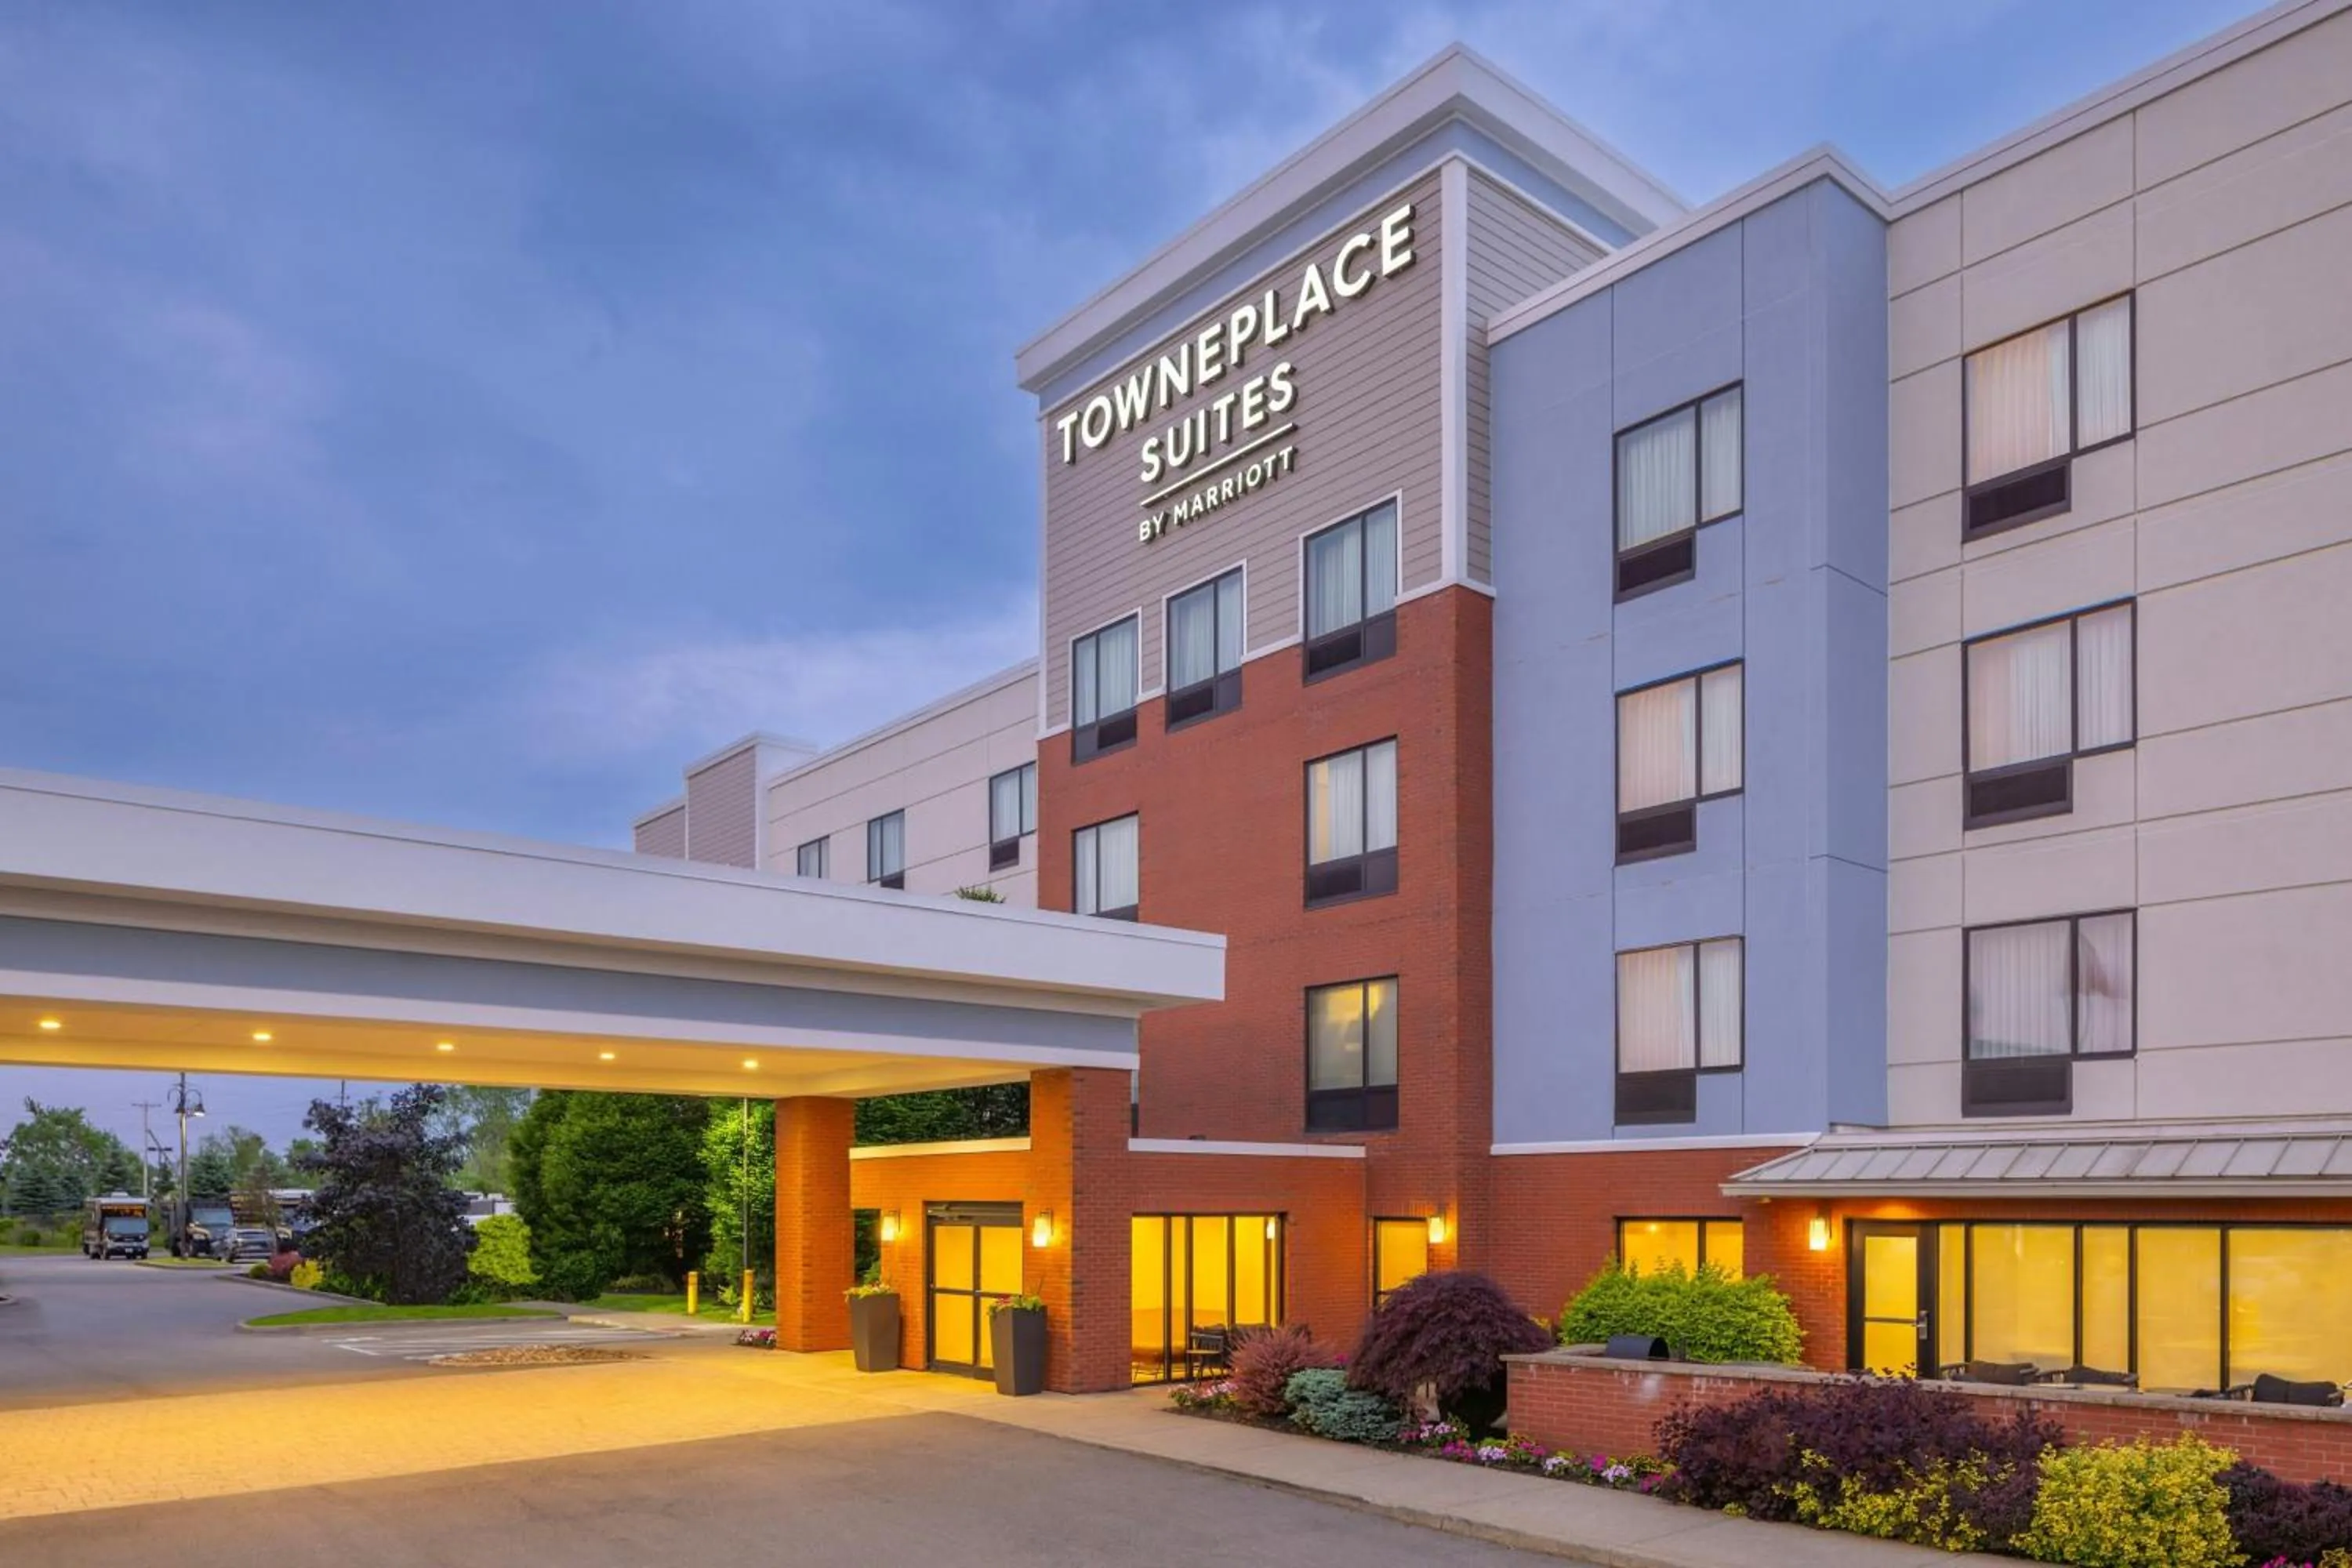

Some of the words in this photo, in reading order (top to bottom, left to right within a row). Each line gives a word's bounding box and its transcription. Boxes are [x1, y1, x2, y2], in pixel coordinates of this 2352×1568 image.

[1057, 203, 1415, 464] TOWNEPLACE
[1140, 362, 1296, 483] SUITES
[1139, 511, 1167, 543] BY
[1173, 445, 1297, 525] MARRIOTT
